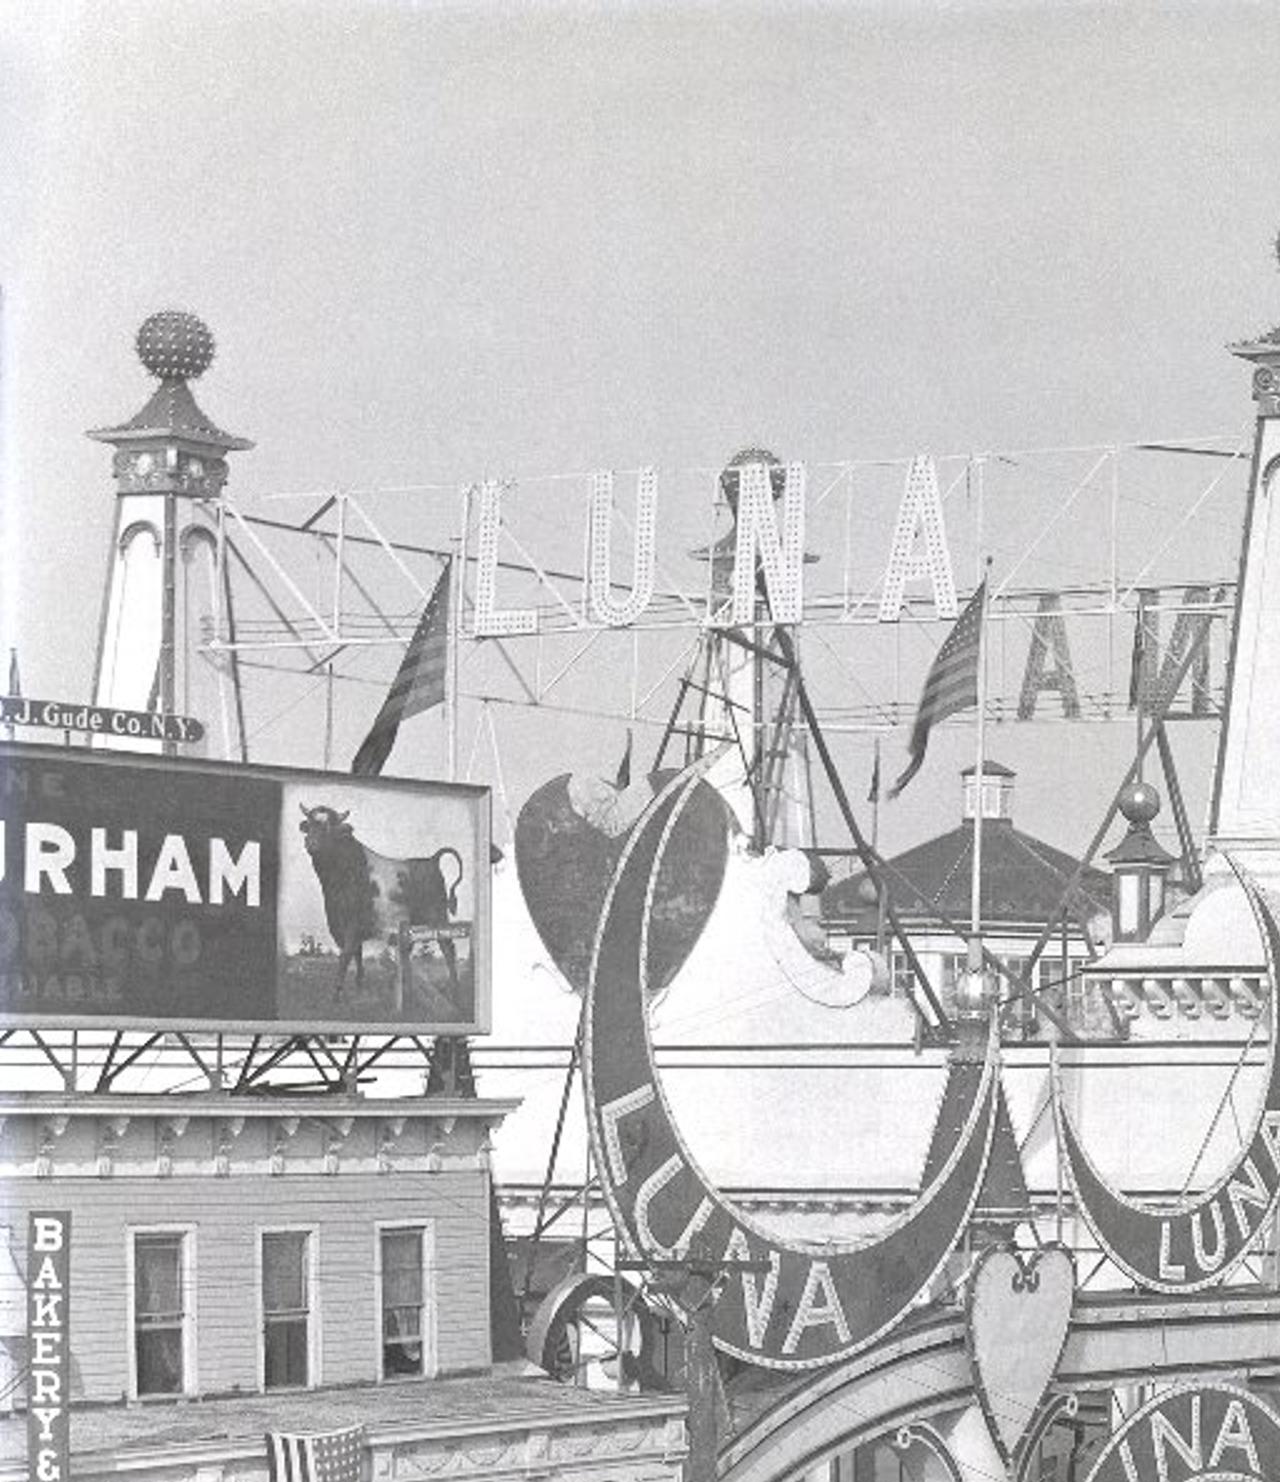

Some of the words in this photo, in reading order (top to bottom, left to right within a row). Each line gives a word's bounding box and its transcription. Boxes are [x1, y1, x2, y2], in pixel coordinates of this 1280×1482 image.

[475, 455, 959, 636] LUNA
[0, 820, 260, 907] RHAM
[602, 1082, 852, 1355] LUNA
[31, 1217, 64, 1441] BAKERY
[37, 1450, 60, 1481] &
